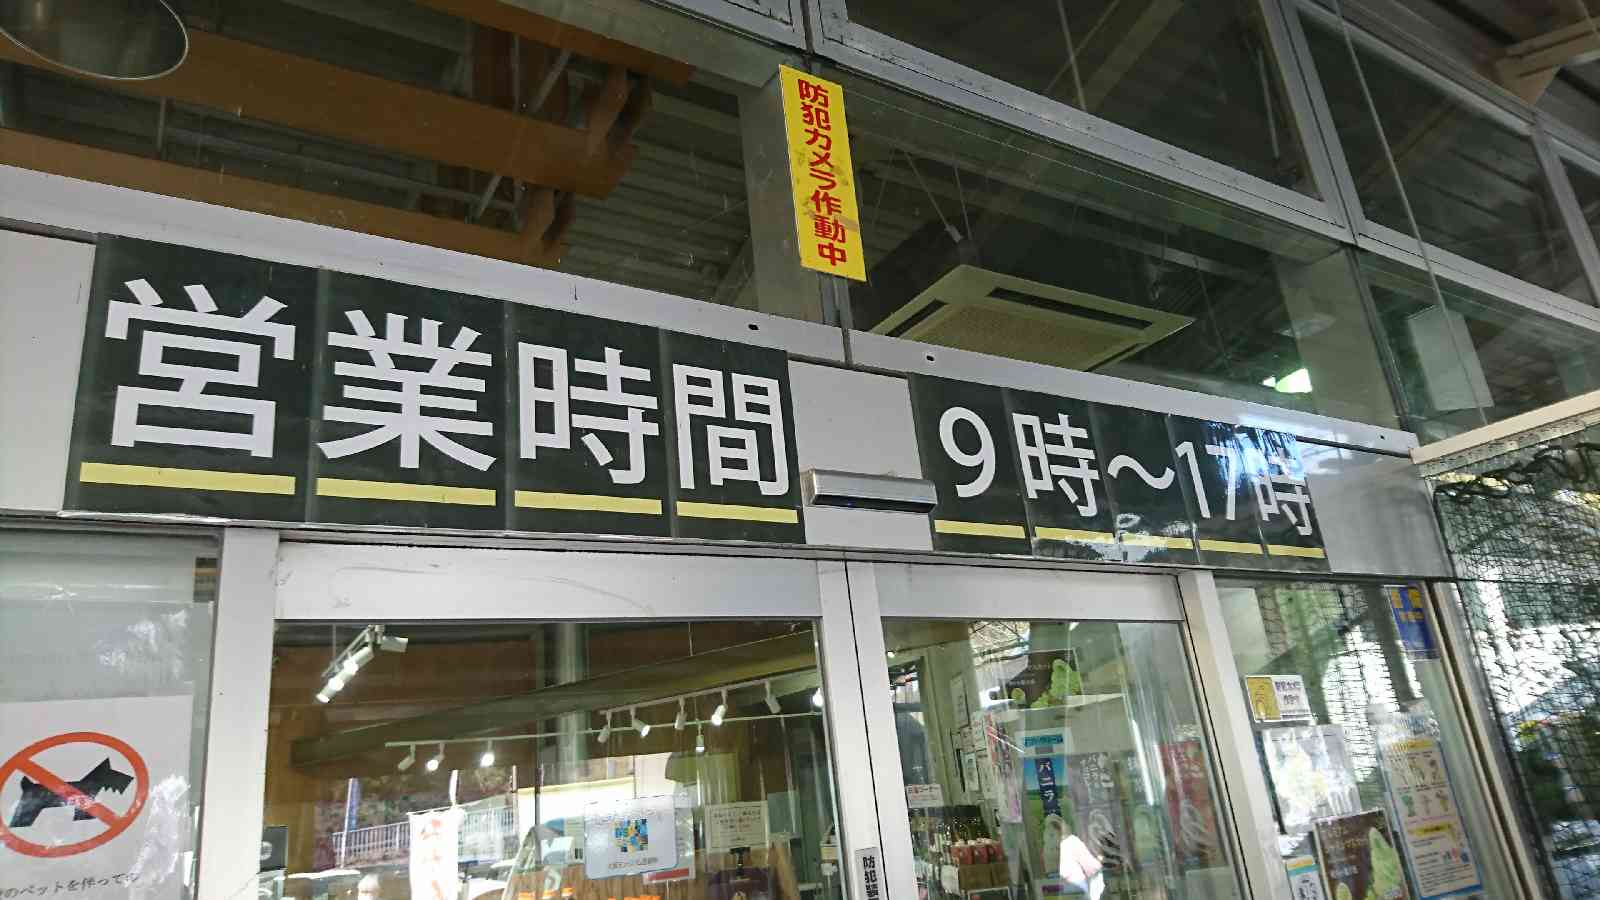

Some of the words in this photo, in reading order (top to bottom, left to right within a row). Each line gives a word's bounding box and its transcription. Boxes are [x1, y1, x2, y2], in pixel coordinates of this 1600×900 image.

[797, 78, 847, 266] 防犯カメラ作動中
[104, 277, 790, 496] 営業時間
